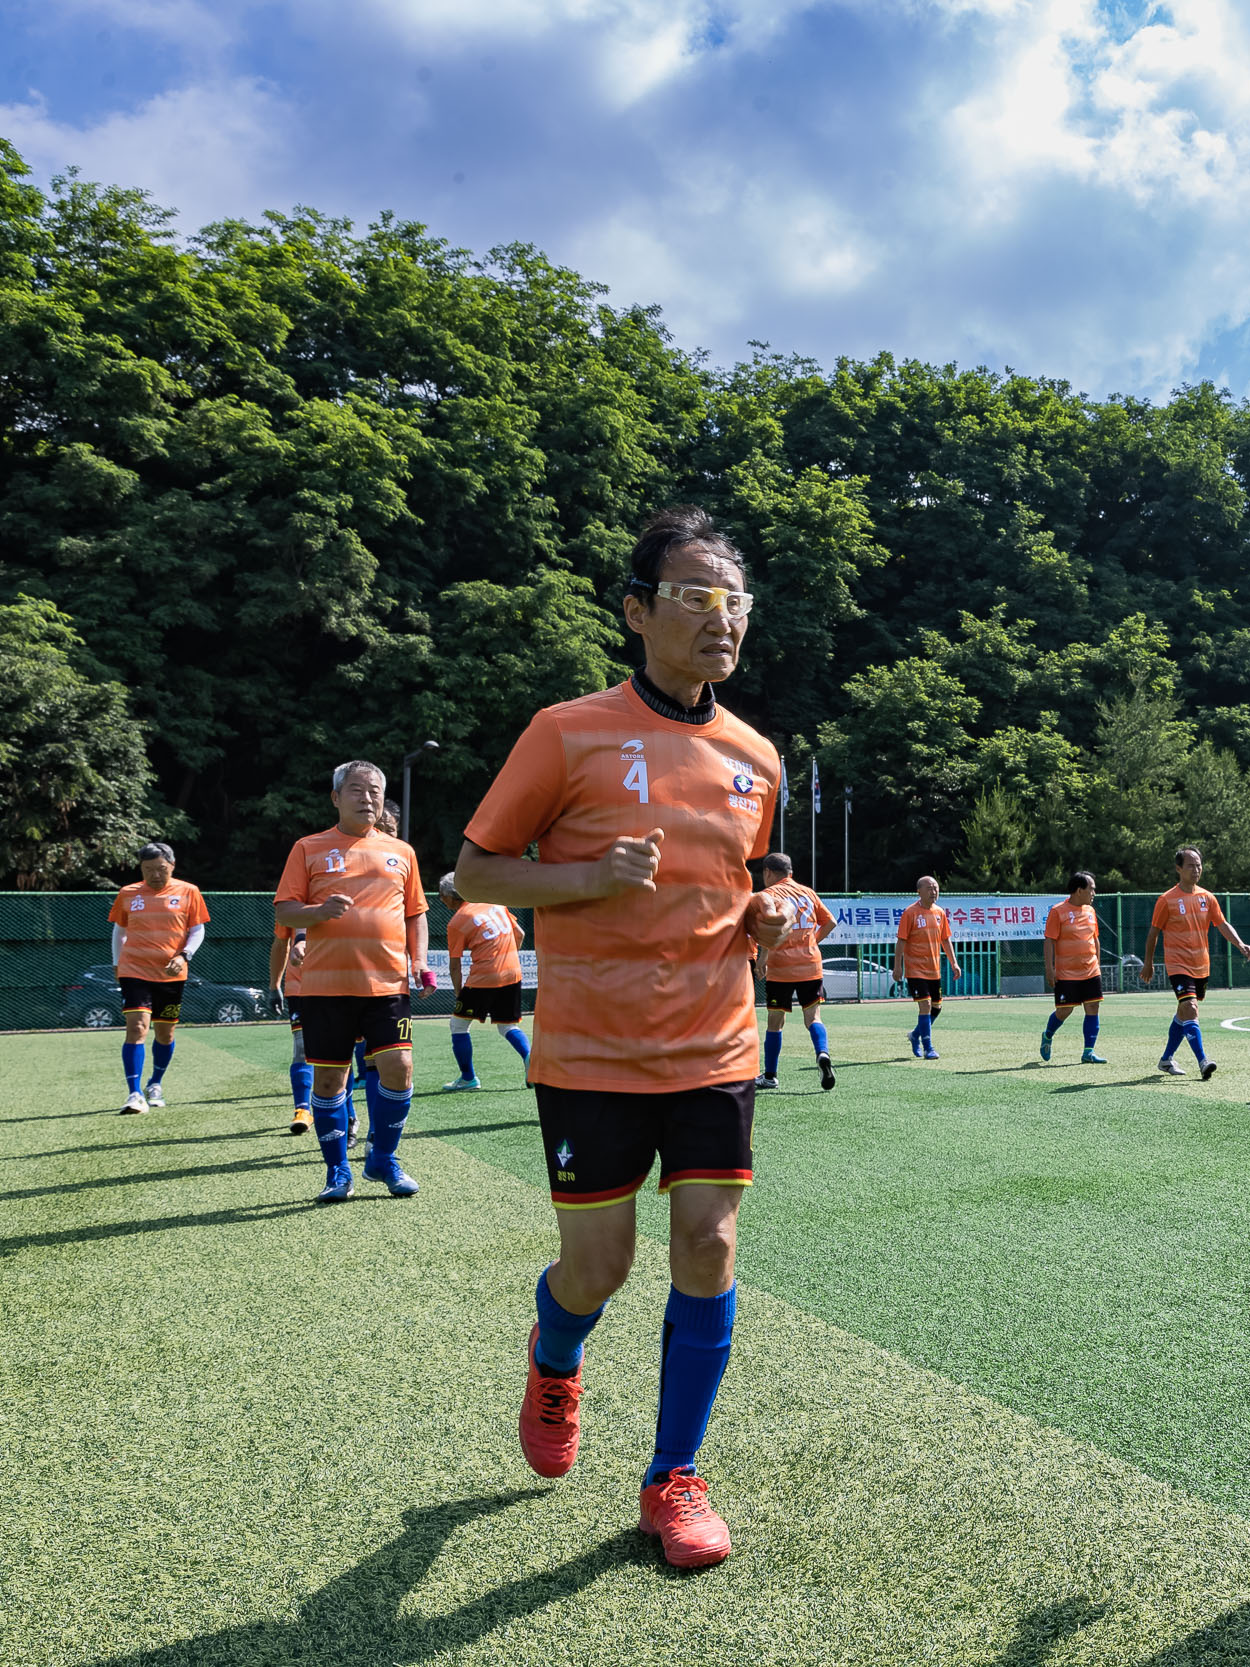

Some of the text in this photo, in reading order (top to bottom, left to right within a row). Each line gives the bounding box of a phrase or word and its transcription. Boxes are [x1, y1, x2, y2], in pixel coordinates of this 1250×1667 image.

[622, 761, 649, 803] 4
[324, 855, 346, 873] 11
[130, 899, 145, 912] 25
[473, 906, 512, 940] 30
[397, 1018, 413, 1040] 1
